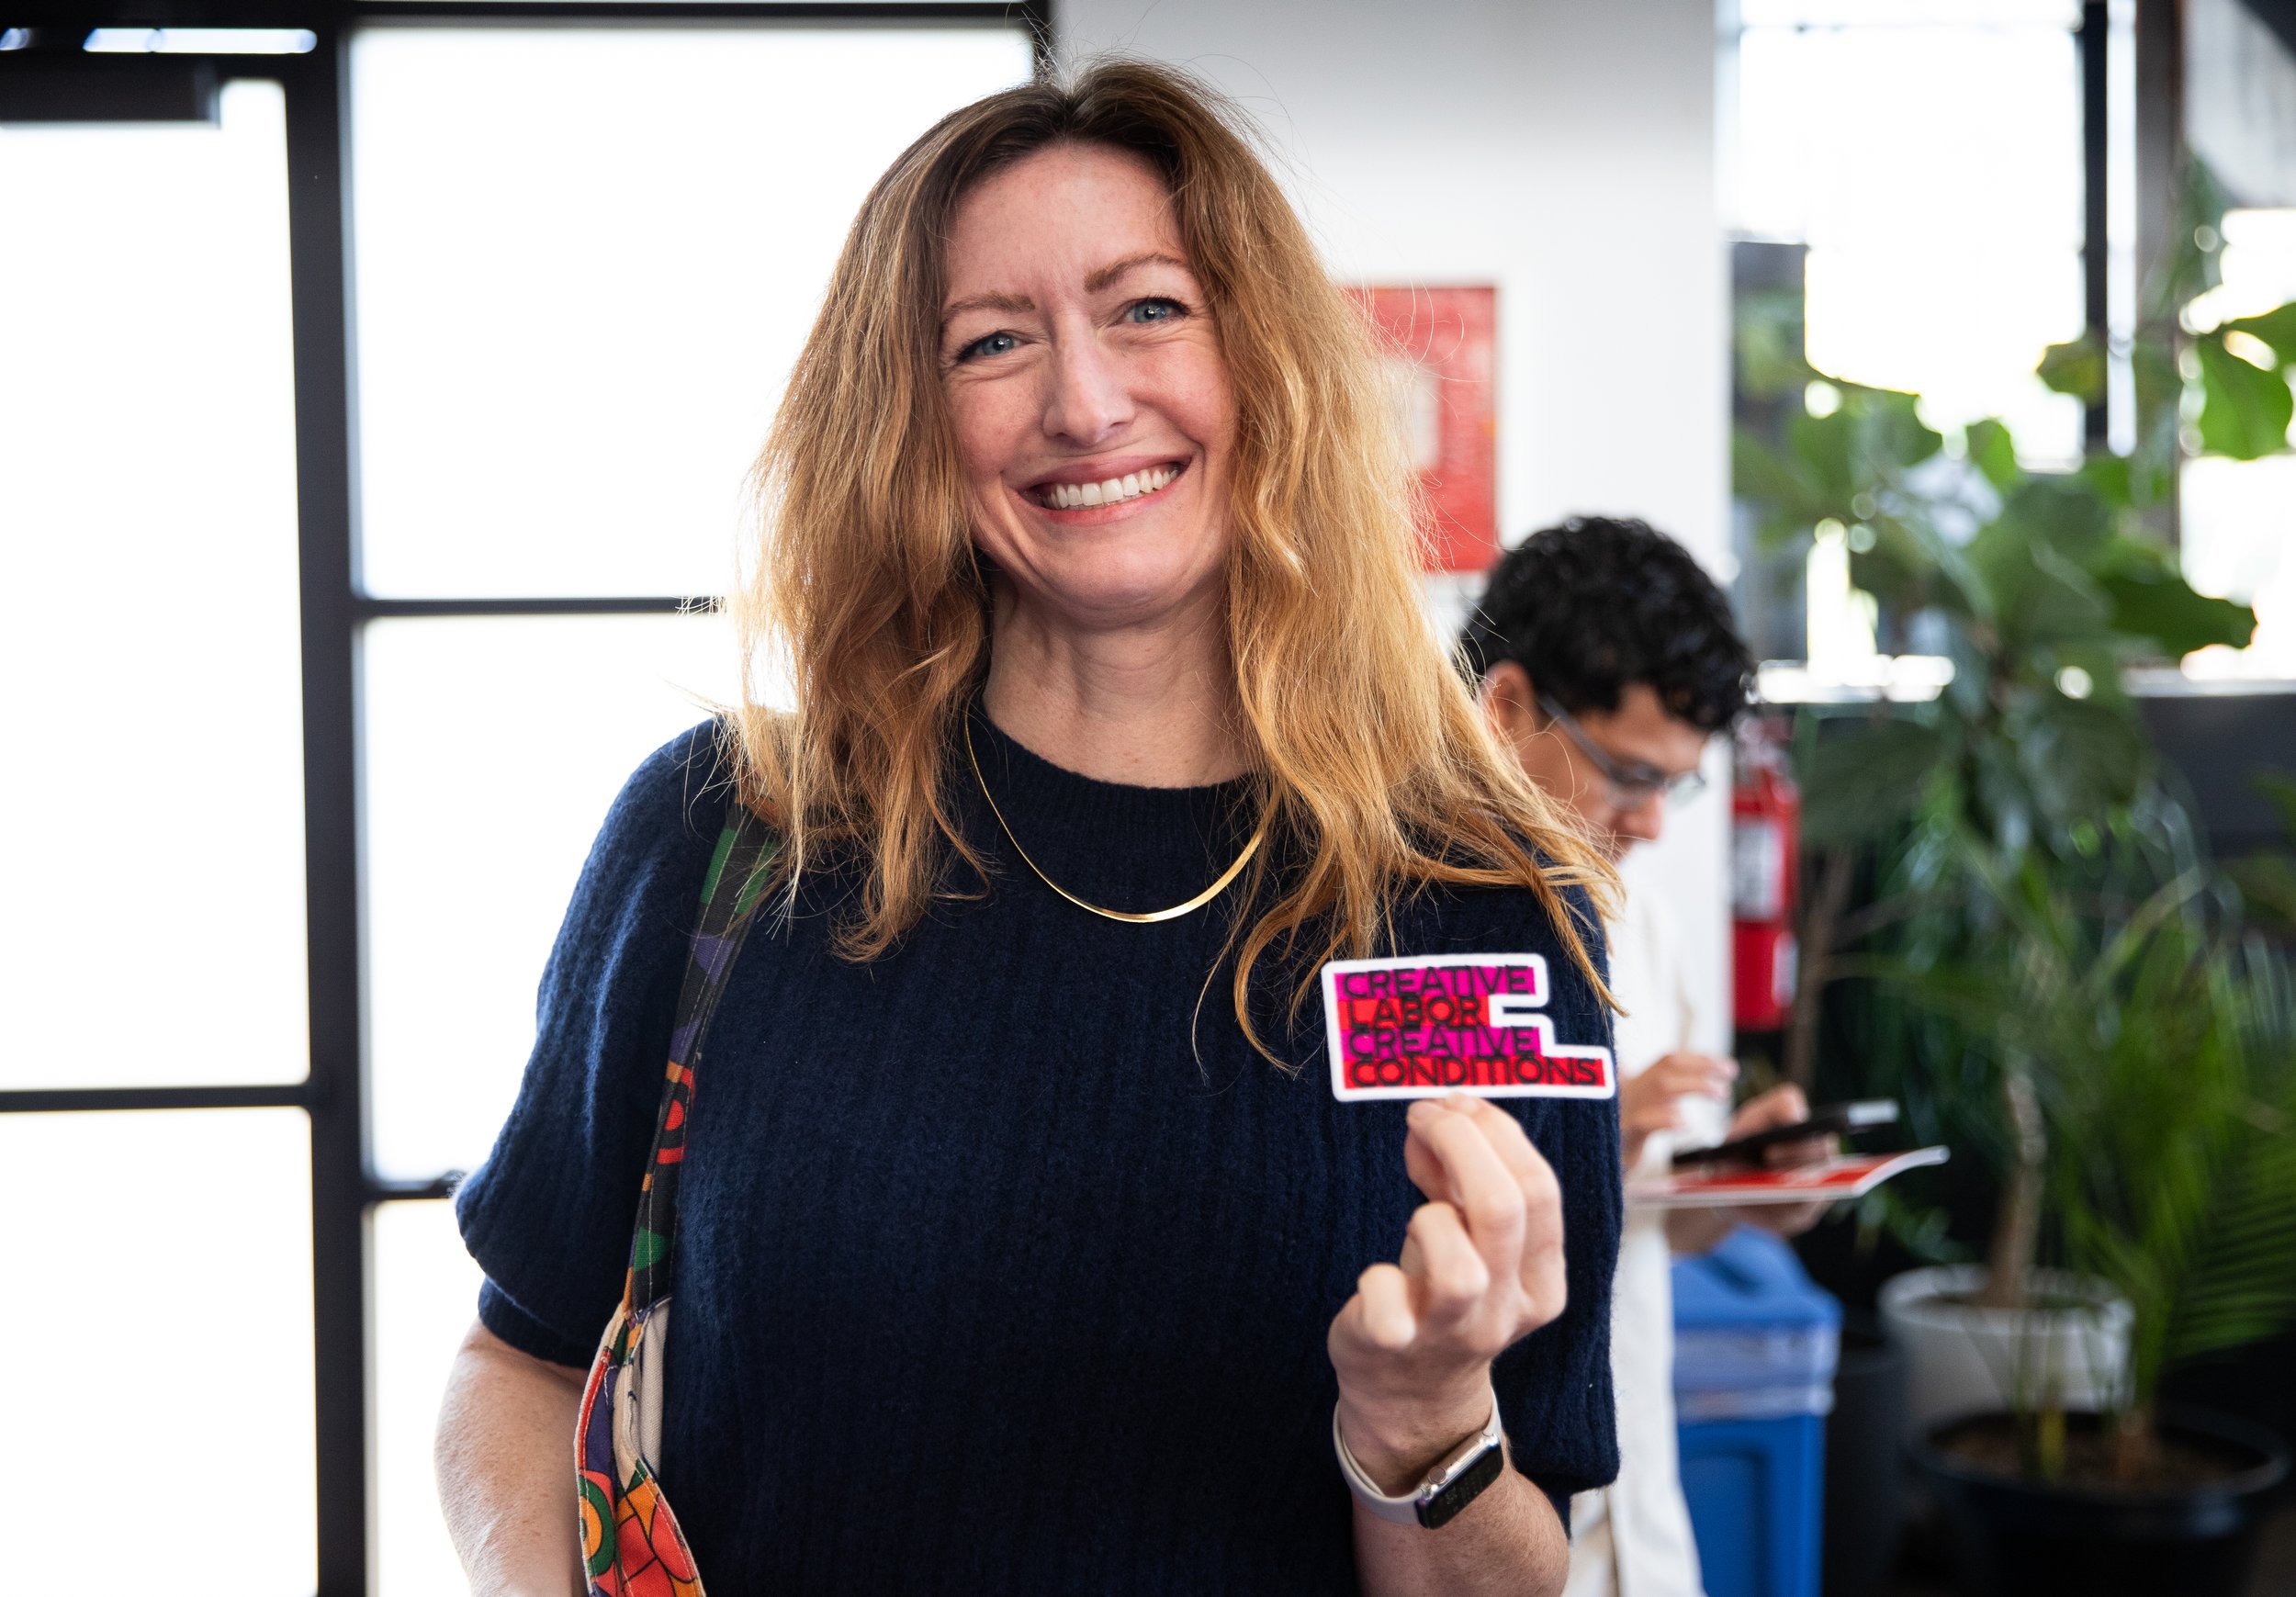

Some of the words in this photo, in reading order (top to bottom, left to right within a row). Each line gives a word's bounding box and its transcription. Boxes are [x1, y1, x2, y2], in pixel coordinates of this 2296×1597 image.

[1344, 965, 1530, 997] CREATIVE
[1347, 995, 1481, 1029] LABOR
[1348, 1026, 1536, 1057] CREATIVE
[1351, 1056, 1598, 1086] CONDITIONS
